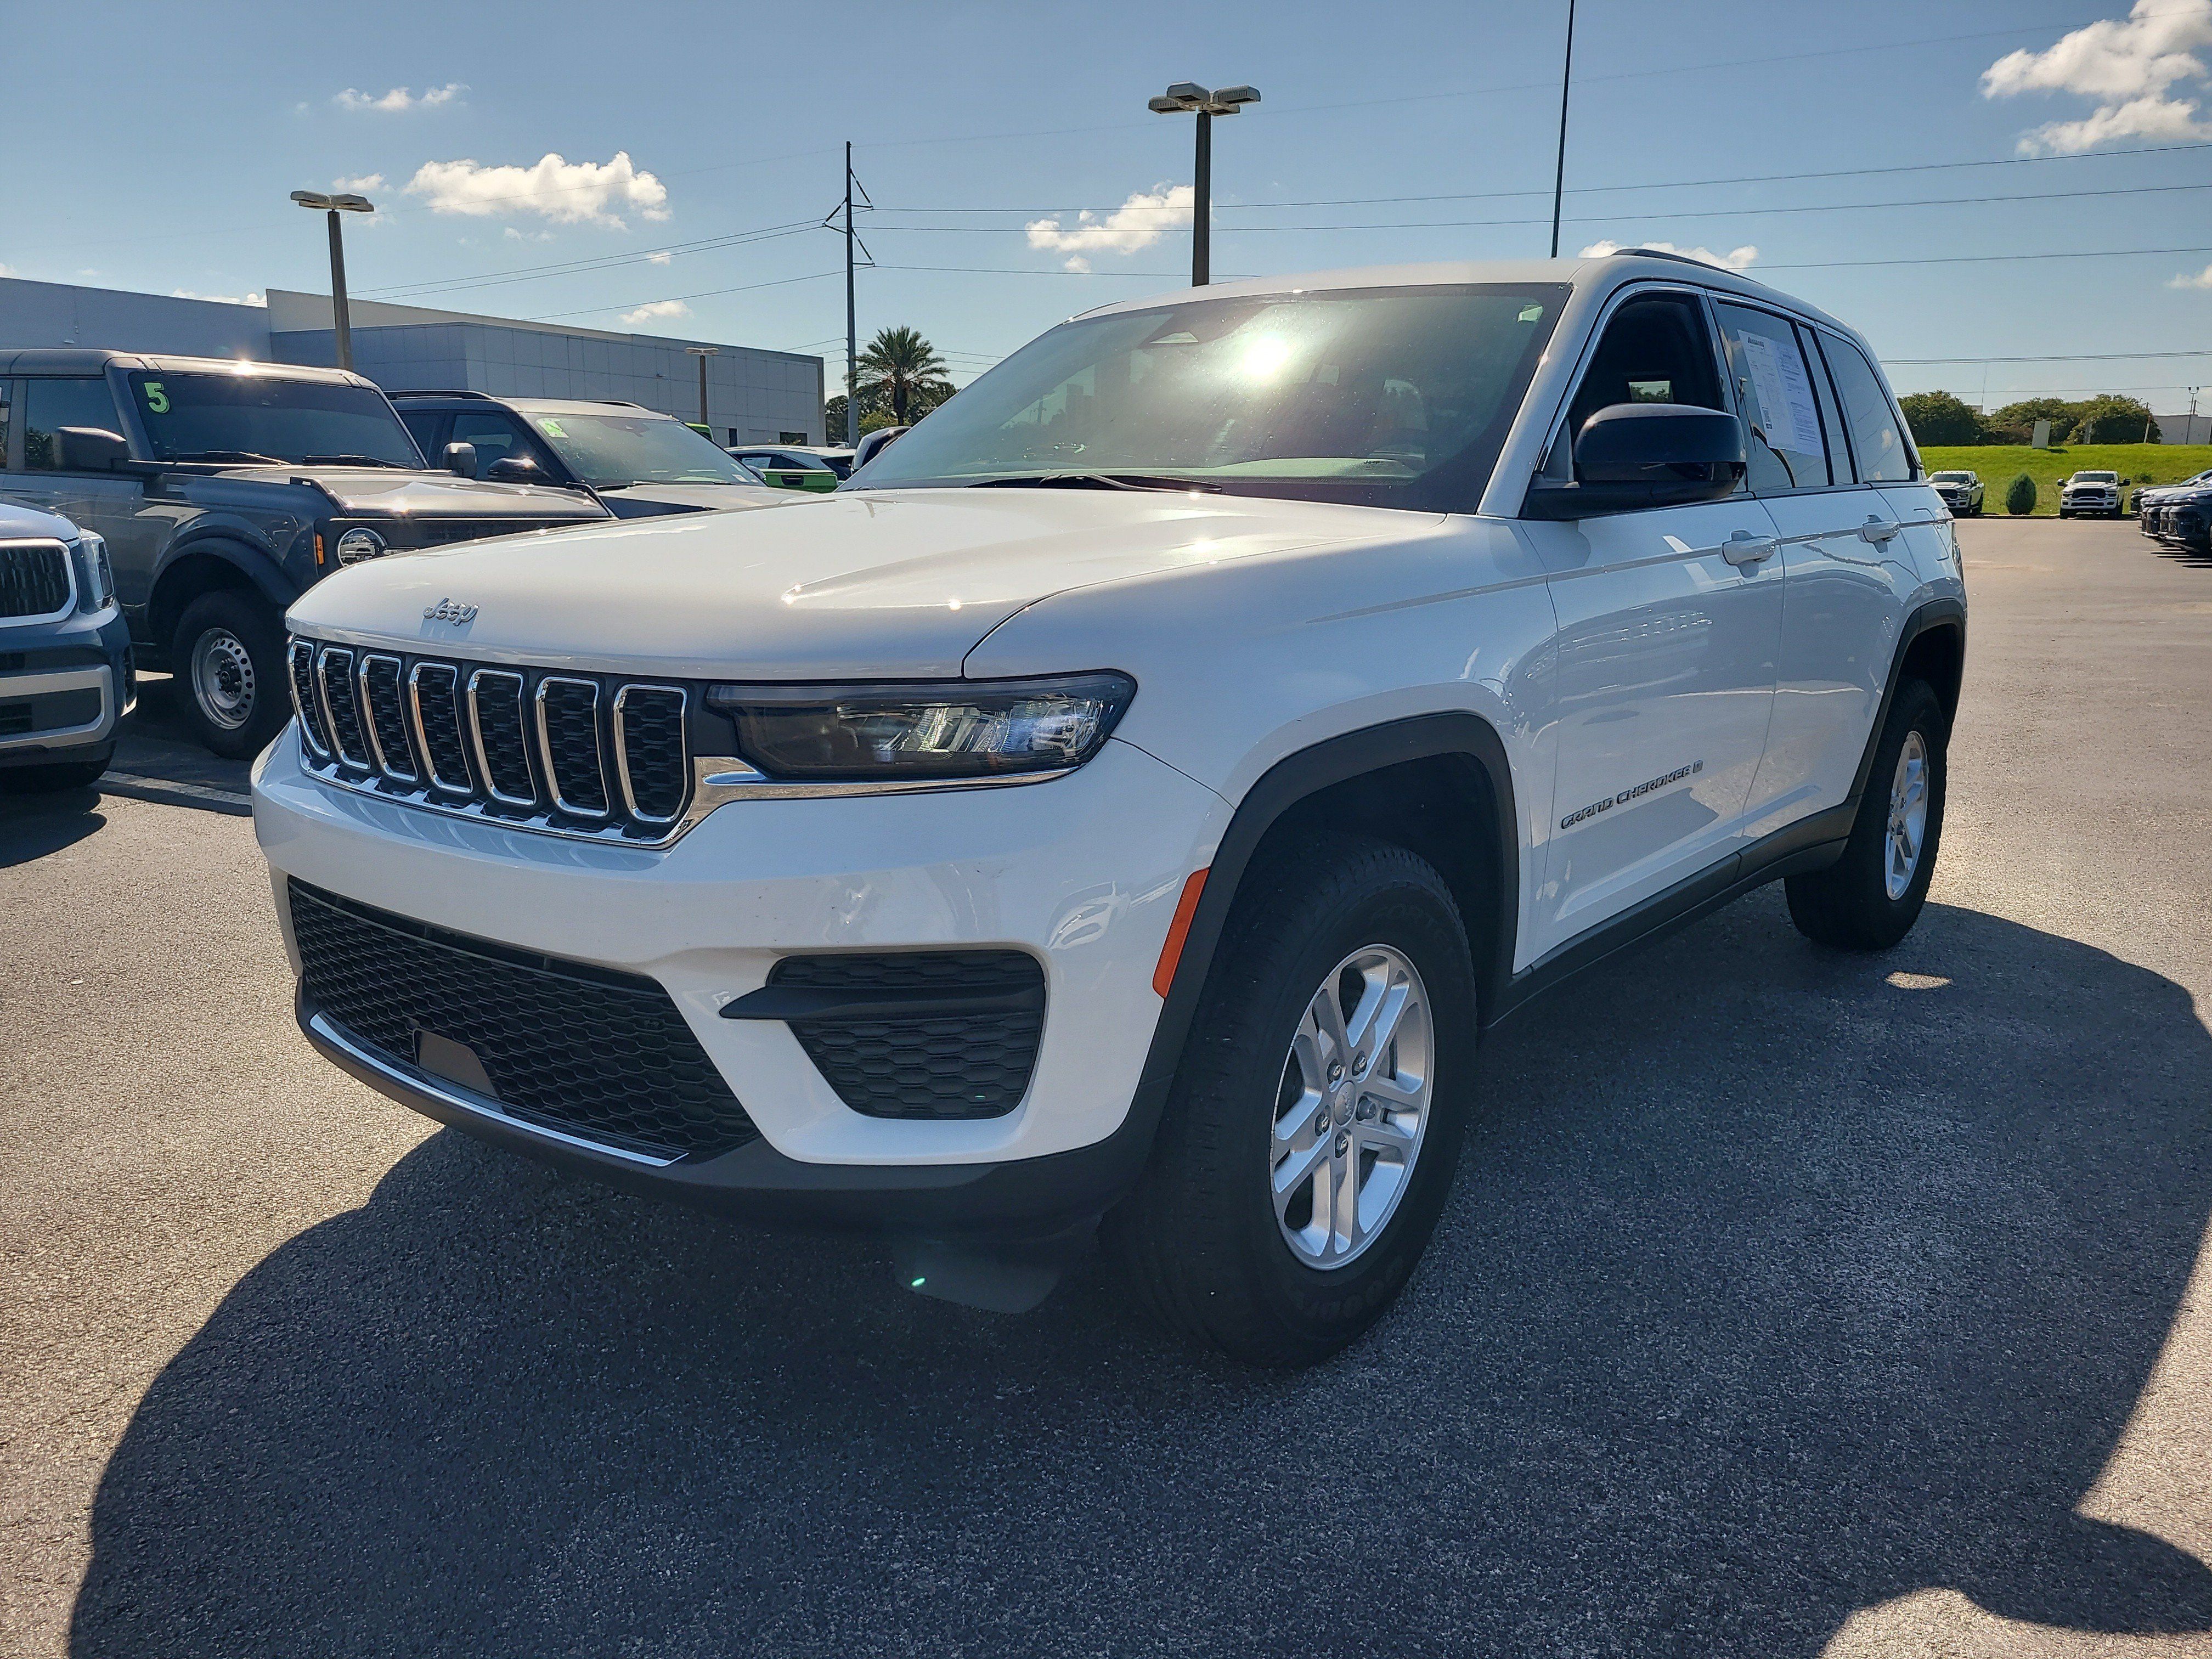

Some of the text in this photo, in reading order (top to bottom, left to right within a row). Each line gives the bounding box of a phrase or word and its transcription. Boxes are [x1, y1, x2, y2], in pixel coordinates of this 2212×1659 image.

[144, 382, 170, 414] 5
[423, 596, 479, 627] Jeep
[1561, 765, 1692, 830] GRAND CHEROKEE
